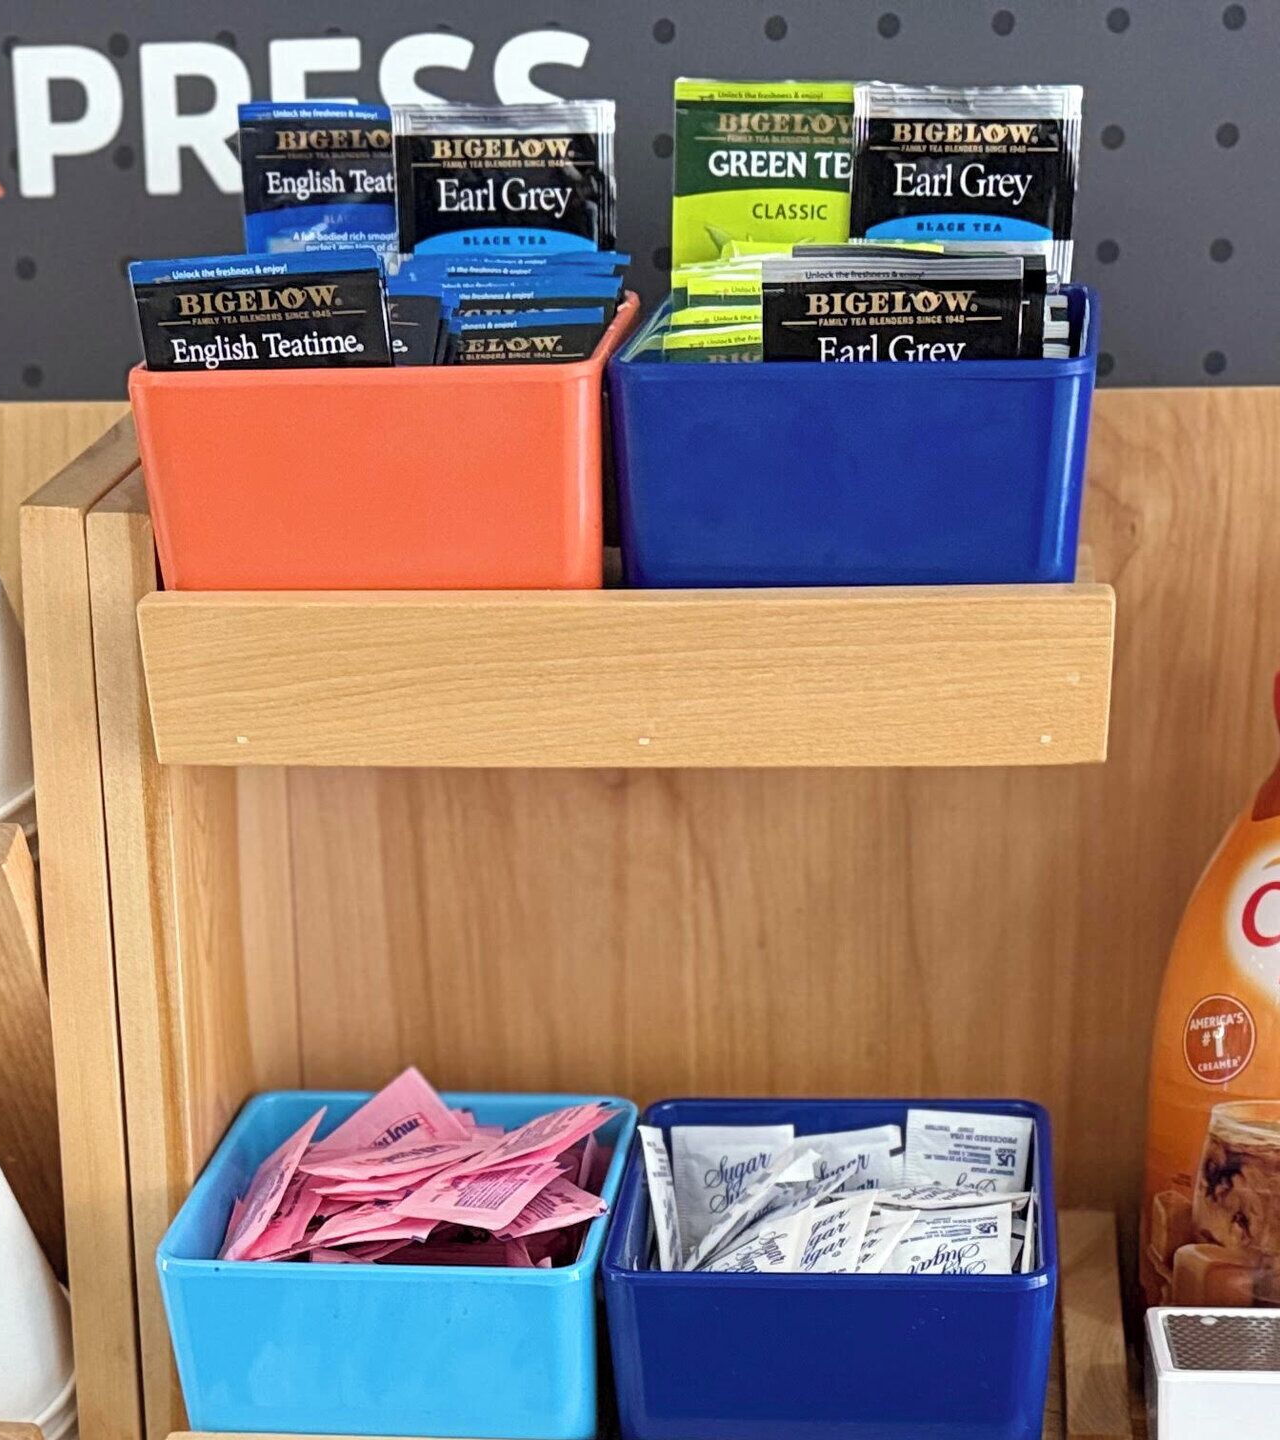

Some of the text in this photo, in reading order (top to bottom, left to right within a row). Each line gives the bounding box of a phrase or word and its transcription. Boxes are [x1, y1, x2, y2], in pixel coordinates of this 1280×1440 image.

[891, 123, 1038, 143] BIGELOW
[431, 139, 574, 159] BIGELOW
[708, 150, 807, 178] GREEN
[266, 169, 346, 200] English
[893, 163, 1033, 206] Earl Grey
[436, 177, 572, 219] Earl Grey
[752, 203, 828, 220] CLASSIC
[916, 222, 1002, 232] BLACK TEA
[463, 236, 547, 246] BLACK TEA
[172, 264, 288, 280] Unlock the freshness & enjoy!
[805, 271, 833, 280] Unlock
[835, 270, 848, 279] the
[850, 270, 889, 279] freshness
[176, 285, 340, 316] BIGELOW
[805, 290, 978, 315] BIGELOW
[192, 316, 220, 325] FAMILY
[222, 315, 238, 324] TEA
[285, 311, 310, 320] SINCE
[819, 317, 848, 326] FAMILY
[851, 317, 867, 326] TEA
[869, 316, 913, 325] BLENDERS
[916, 315, 941, 323] SINCE
[170, 333, 259, 369] English
[458, 336, 562, 352] ELOW
[817, 333, 966, 362] Earl Grey
[1189, 1012, 1245, 1031] AMERICA'S
[704, 1152, 772, 1189] Sugar
